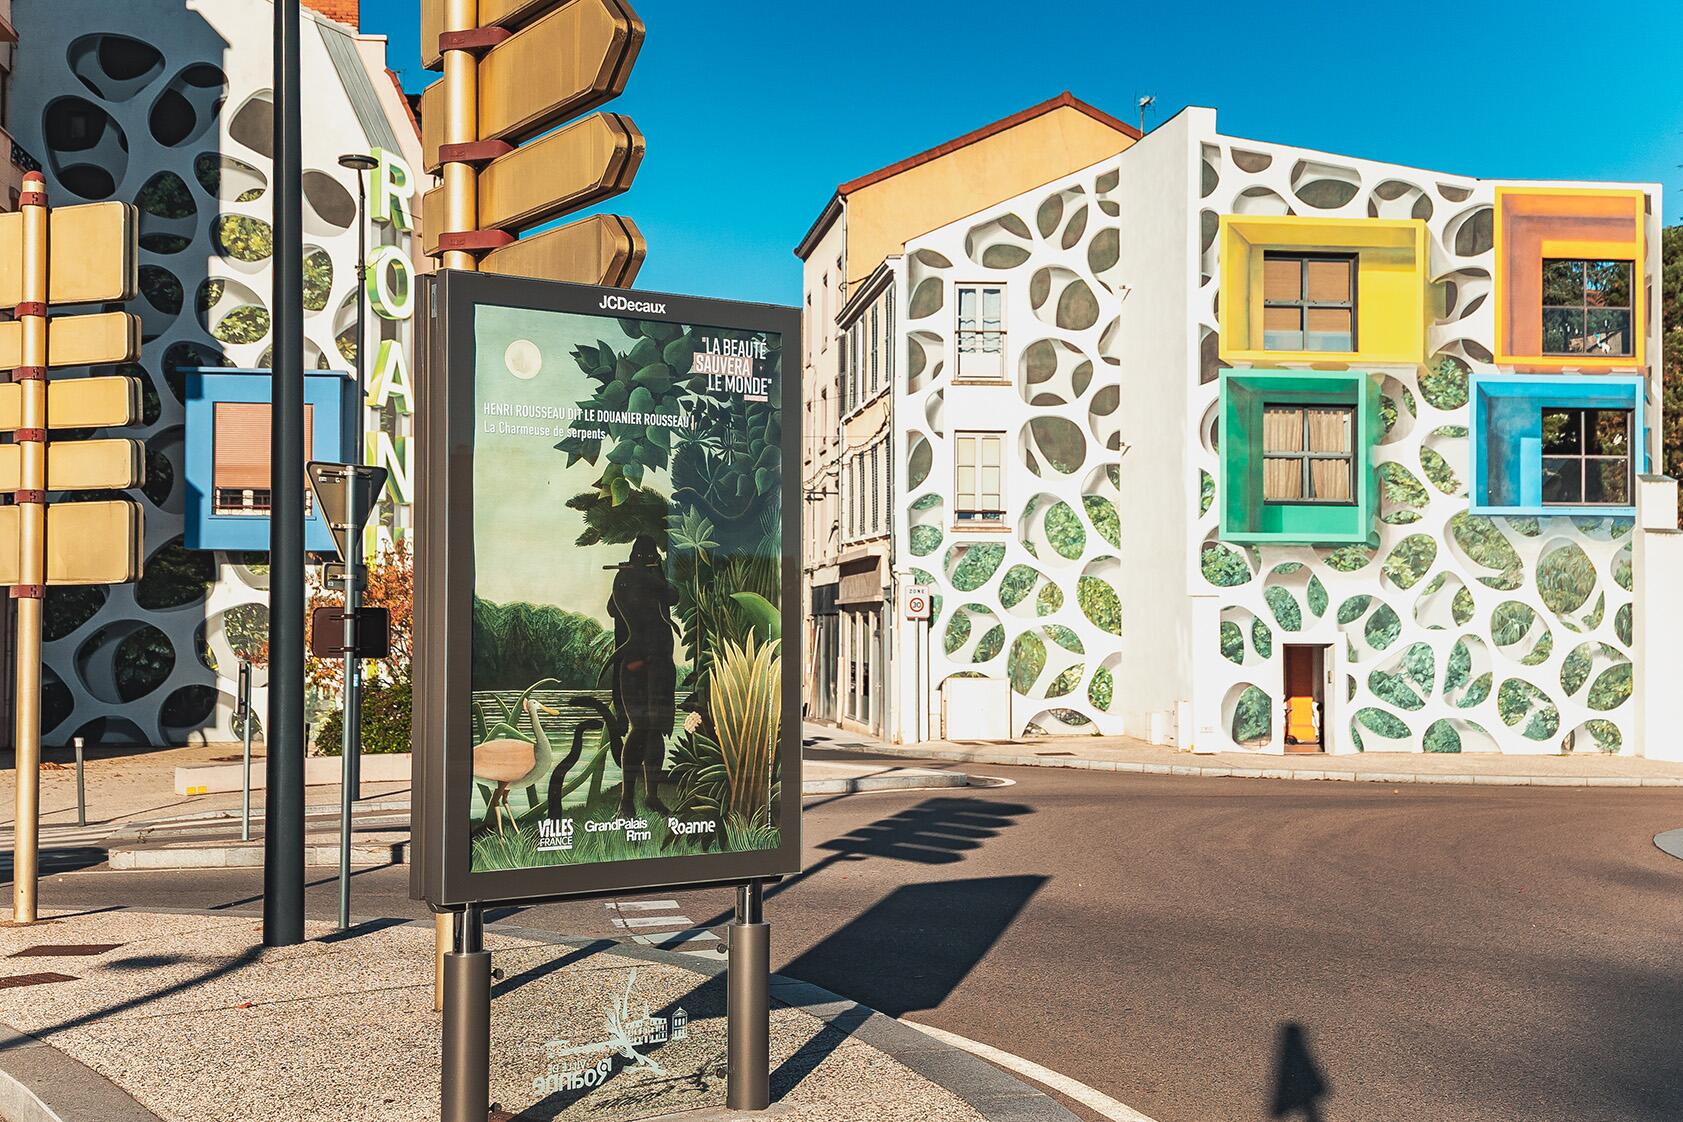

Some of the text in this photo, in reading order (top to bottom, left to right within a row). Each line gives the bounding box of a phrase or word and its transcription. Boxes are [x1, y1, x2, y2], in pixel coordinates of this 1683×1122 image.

[599, 295, 666, 314] JCDecaux
[723, 336, 767, 360] BEAUTÉ
[695, 354, 751, 377] SAUVERA
[708, 373, 722, 392] LE
[483, 402, 690, 428] HENRI ROUSSEAU DIT LE DOUANIER ROUSSEAU
[484, 420, 606, 442] La Charmeuse de serpents
[912, 601, 922, 609] 30
[584, 817, 648, 833] GrandPalais
[668, 817, 716, 835] Roanne
[540, 836, 573, 847] FRANCE
[626, 830, 651, 842] Rmn
